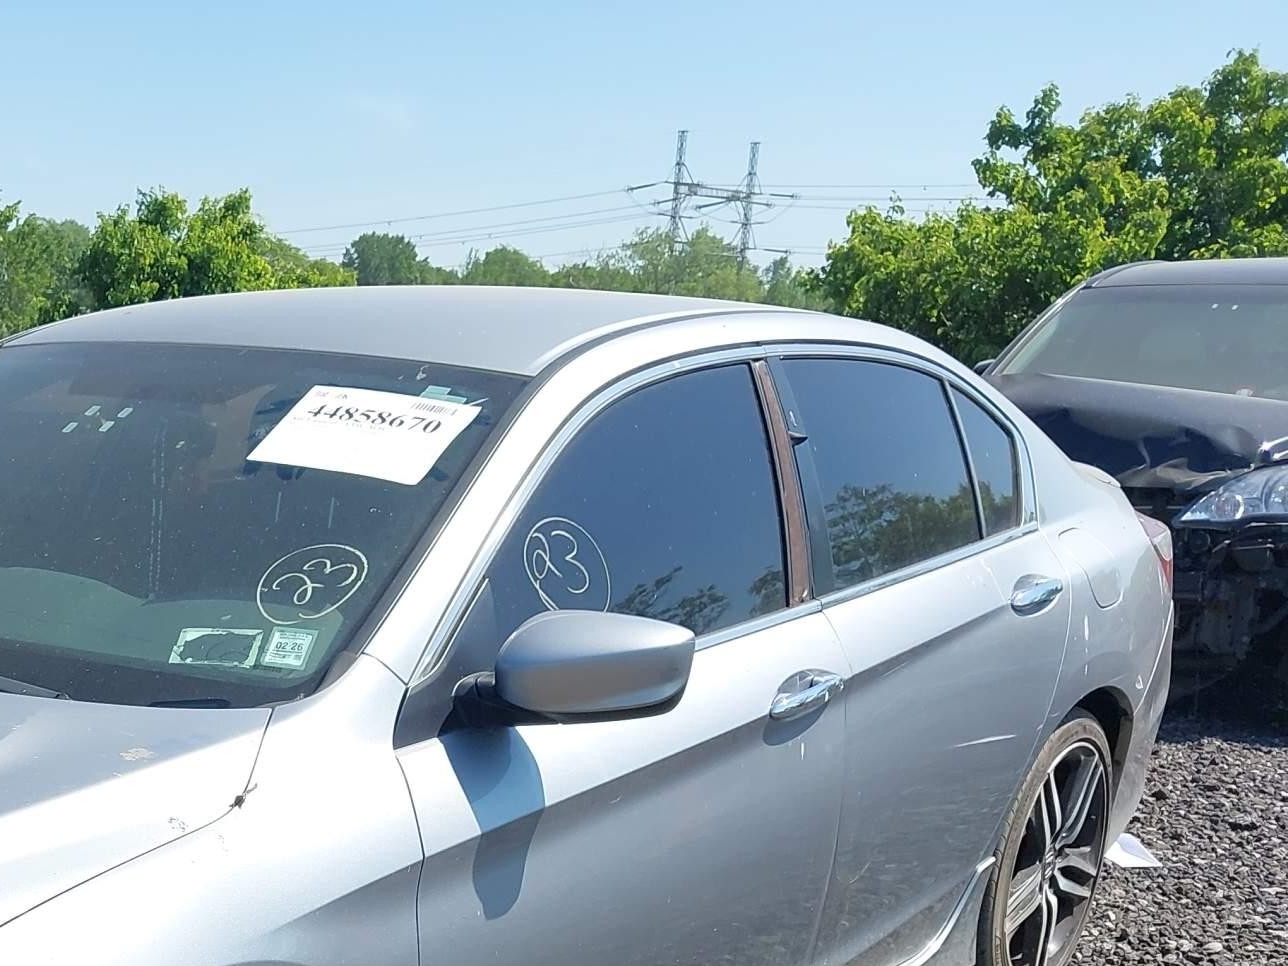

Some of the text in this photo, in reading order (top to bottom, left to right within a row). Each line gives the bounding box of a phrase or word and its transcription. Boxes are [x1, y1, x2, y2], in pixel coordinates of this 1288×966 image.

[308, 403, 442, 434] 44858670
[272, 557, 358, 606] 23
[532, 529, 591, 594] 23
[275, 641, 304, 651] 02 26
